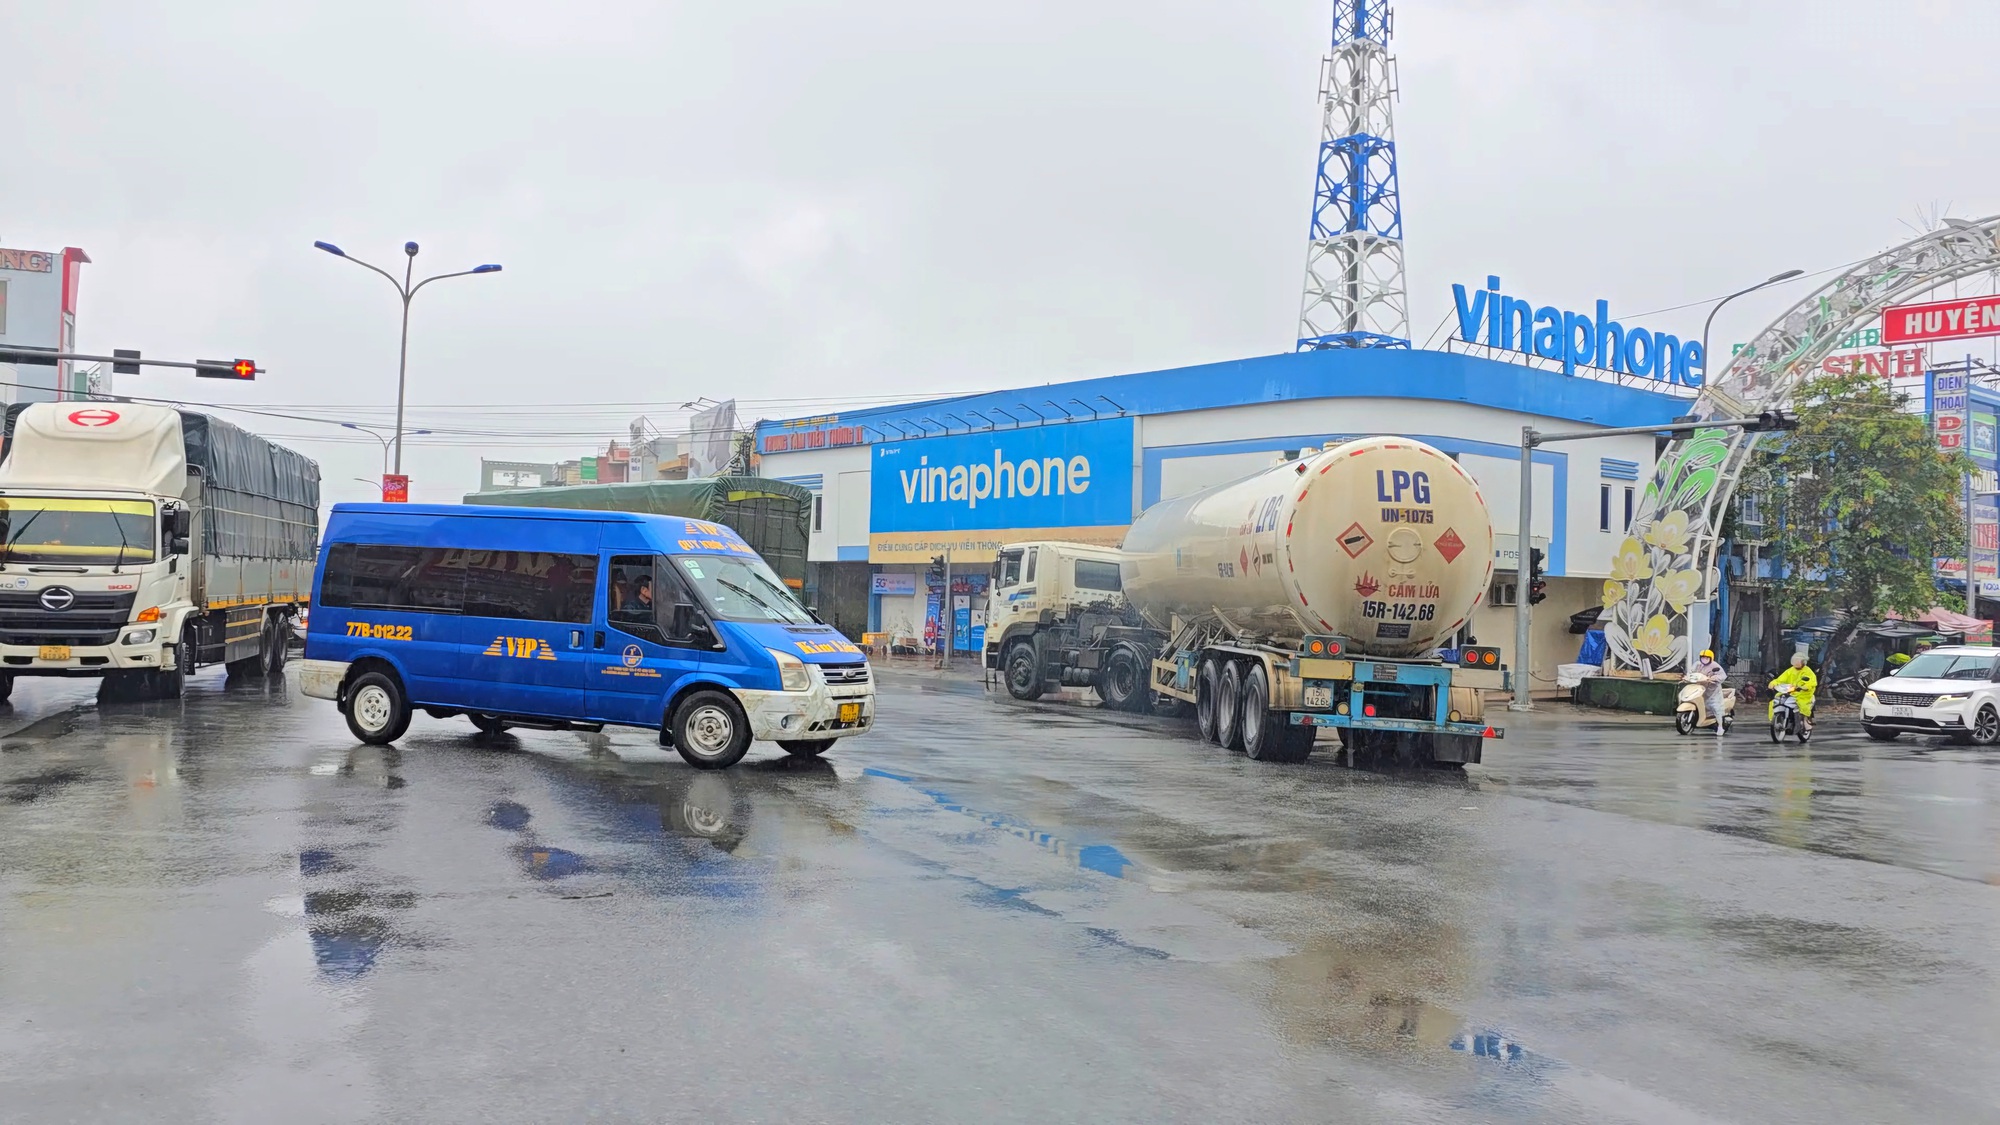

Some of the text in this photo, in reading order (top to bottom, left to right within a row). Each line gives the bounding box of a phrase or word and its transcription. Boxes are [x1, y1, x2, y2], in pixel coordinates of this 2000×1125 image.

[1452, 275, 1703, 387] vinaphone
[1905, 305, 2000, 335] HUYỆN
[900, 449, 1091, 509] vinaphone
[1375, 469, 1431, 504] LPG
[1380, 508, 1433, 524] UN-1075
[1388, 581, 1416, 599] CẤM
[1361, 600, 1435, 621] 15R-142.68
[345, 621, 413, 642] 77B-012.22
